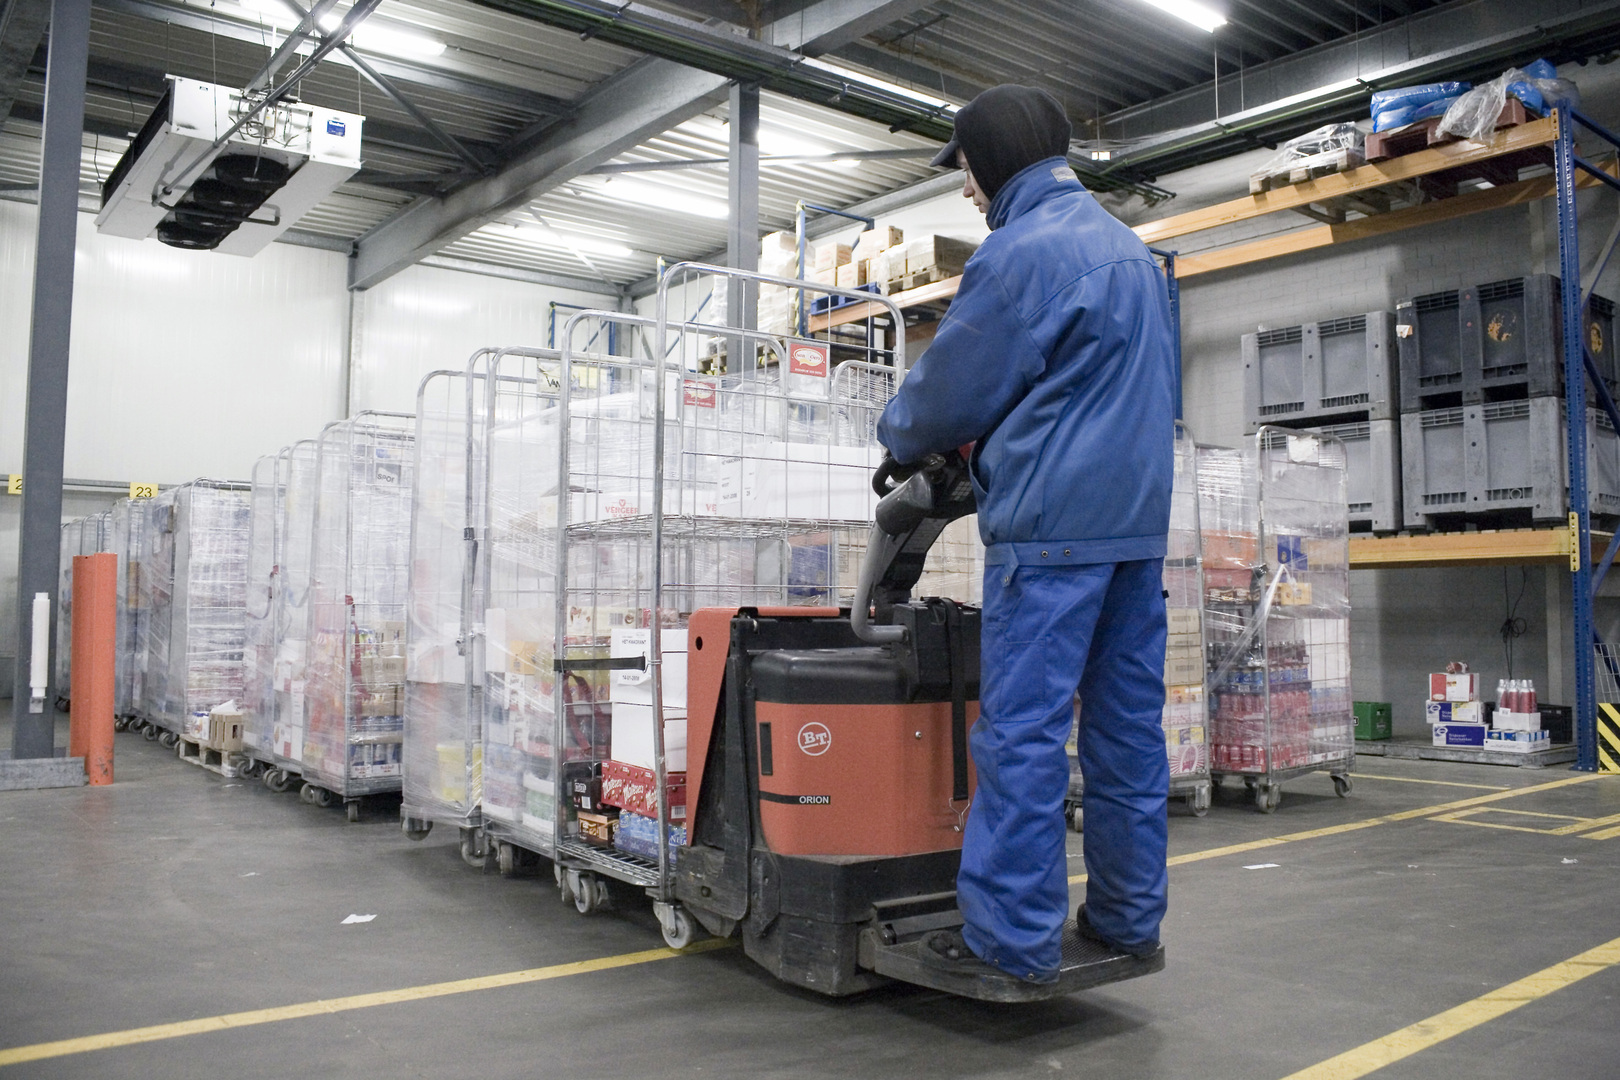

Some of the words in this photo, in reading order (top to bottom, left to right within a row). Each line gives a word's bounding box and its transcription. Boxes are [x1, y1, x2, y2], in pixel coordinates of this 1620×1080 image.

[15, 479, 23, 490] 2
[136, 486, 152, 498] 23
[799, 795, 830, 804] ORION
